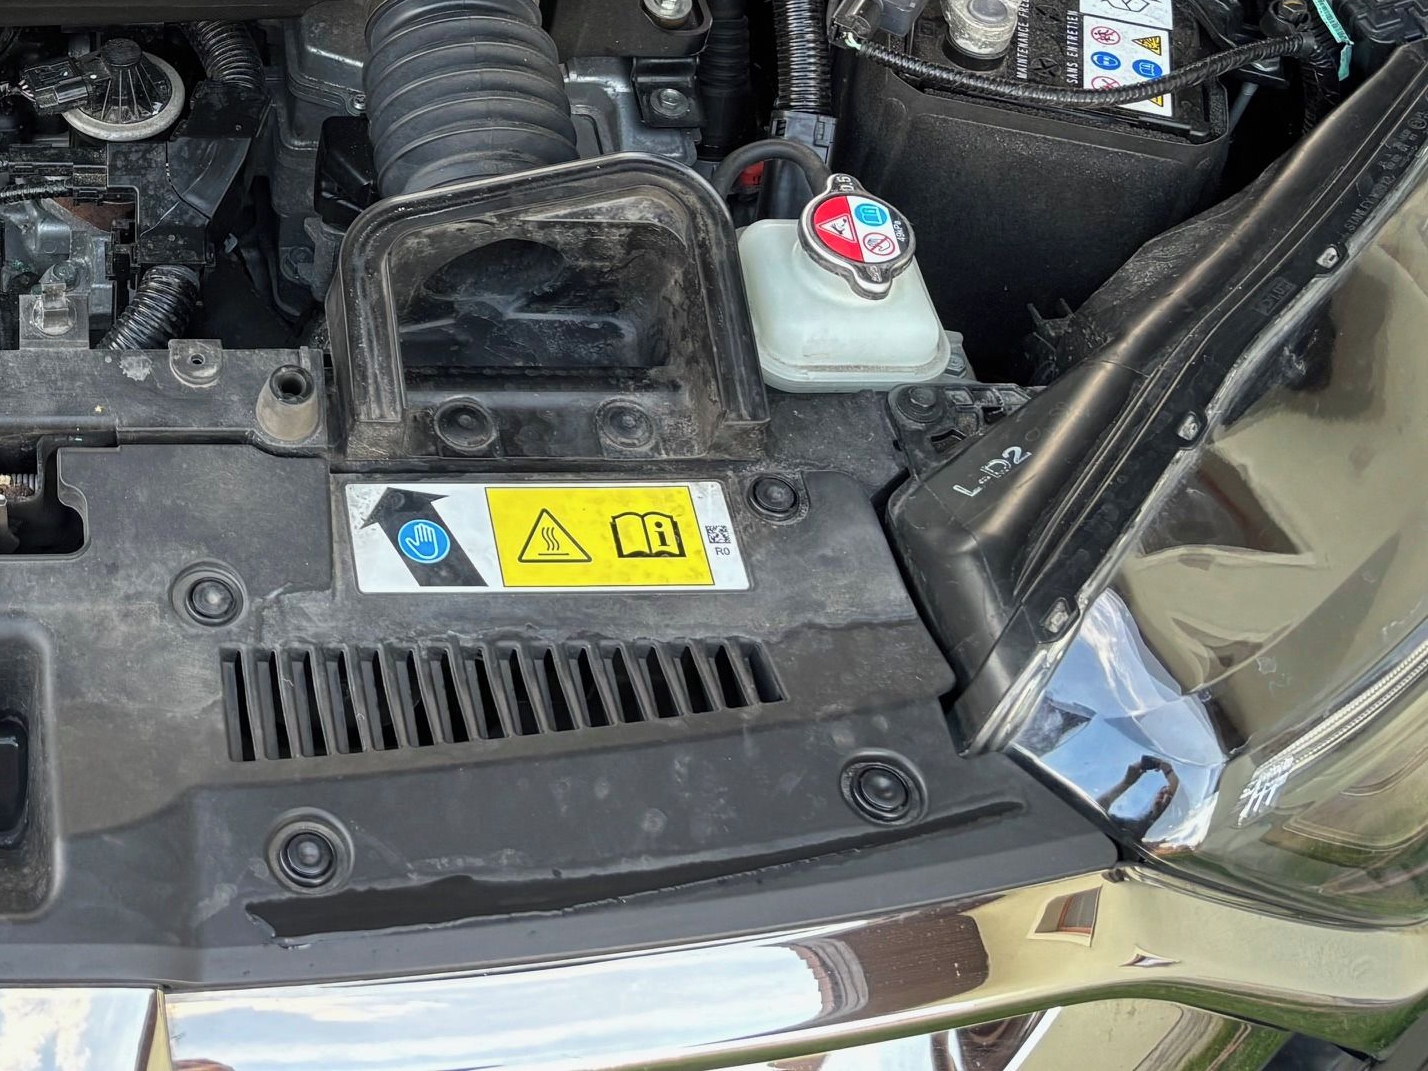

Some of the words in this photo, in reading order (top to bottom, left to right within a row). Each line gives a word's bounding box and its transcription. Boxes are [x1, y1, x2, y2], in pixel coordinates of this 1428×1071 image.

[1016, 22, 1029, 79] MAINTENANCE
[1066, 10, 1079, 58] ENTRETIEN
[1066, 61, 1079, 84] SANS
